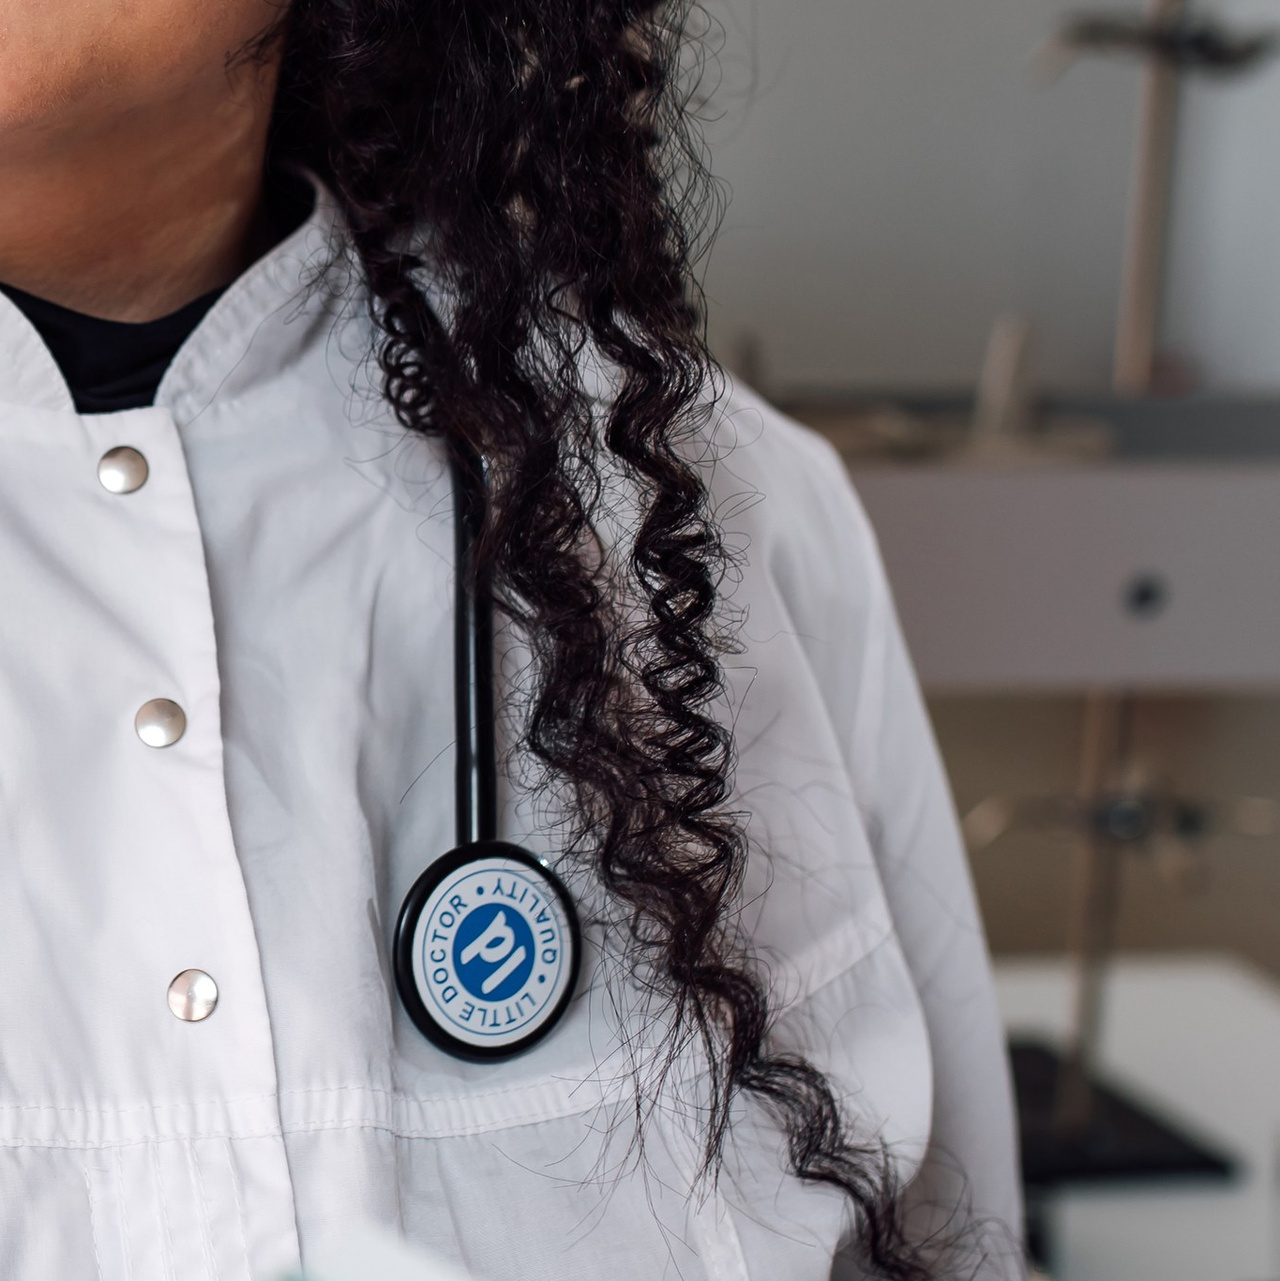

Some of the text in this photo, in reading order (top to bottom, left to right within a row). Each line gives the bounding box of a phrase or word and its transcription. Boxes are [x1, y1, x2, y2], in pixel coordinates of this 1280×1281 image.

[430, 894, 537, 1027] LITTLE DOCTOR
[492, 877, 558, 965] QUALITY
